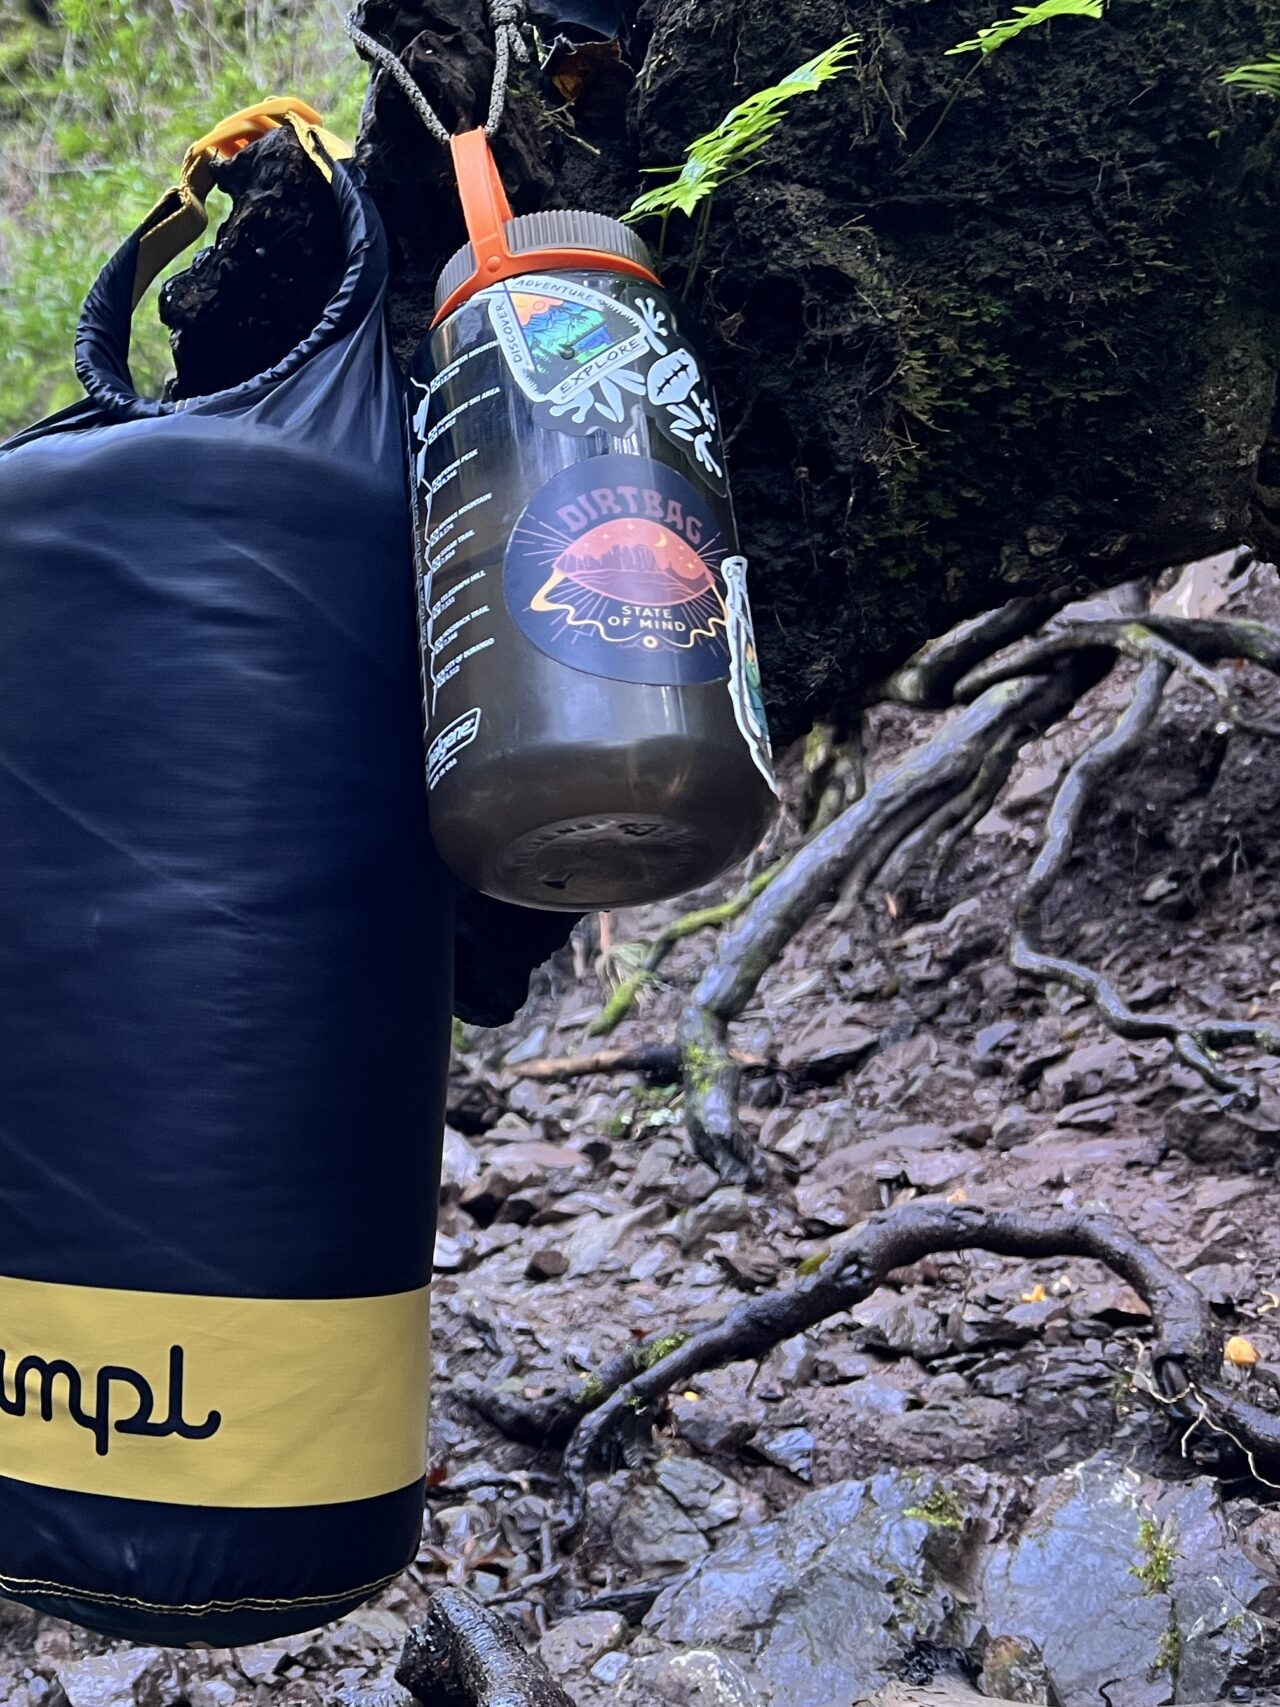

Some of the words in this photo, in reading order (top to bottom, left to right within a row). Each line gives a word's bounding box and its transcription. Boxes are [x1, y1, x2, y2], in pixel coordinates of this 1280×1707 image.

[515, 279, 595, 302] ADVENTURE
[495, 304, 523, 363] DISCOVER
[560, 338, 640, 394] EXPLORE
[481, 386, 500, 400] AREA
[460, 448, 478, 463] PEAK
[458, 492, 493, 515] MOUNTAIN
[556, 485, 703, 545] DIRTBAG
[457, 529, 475, 543] TRAIL
[470, 569, 486, 582] HILL
[470, 605, 490, 619] TRAIL
[621, 605, 673, 619] STATE
[607, 616, 632, 627] OF
[639, 618, 686, 632] MIND
[444, 659, 456, 672] CITY
[463, 637, 495, 659] DURANGO
